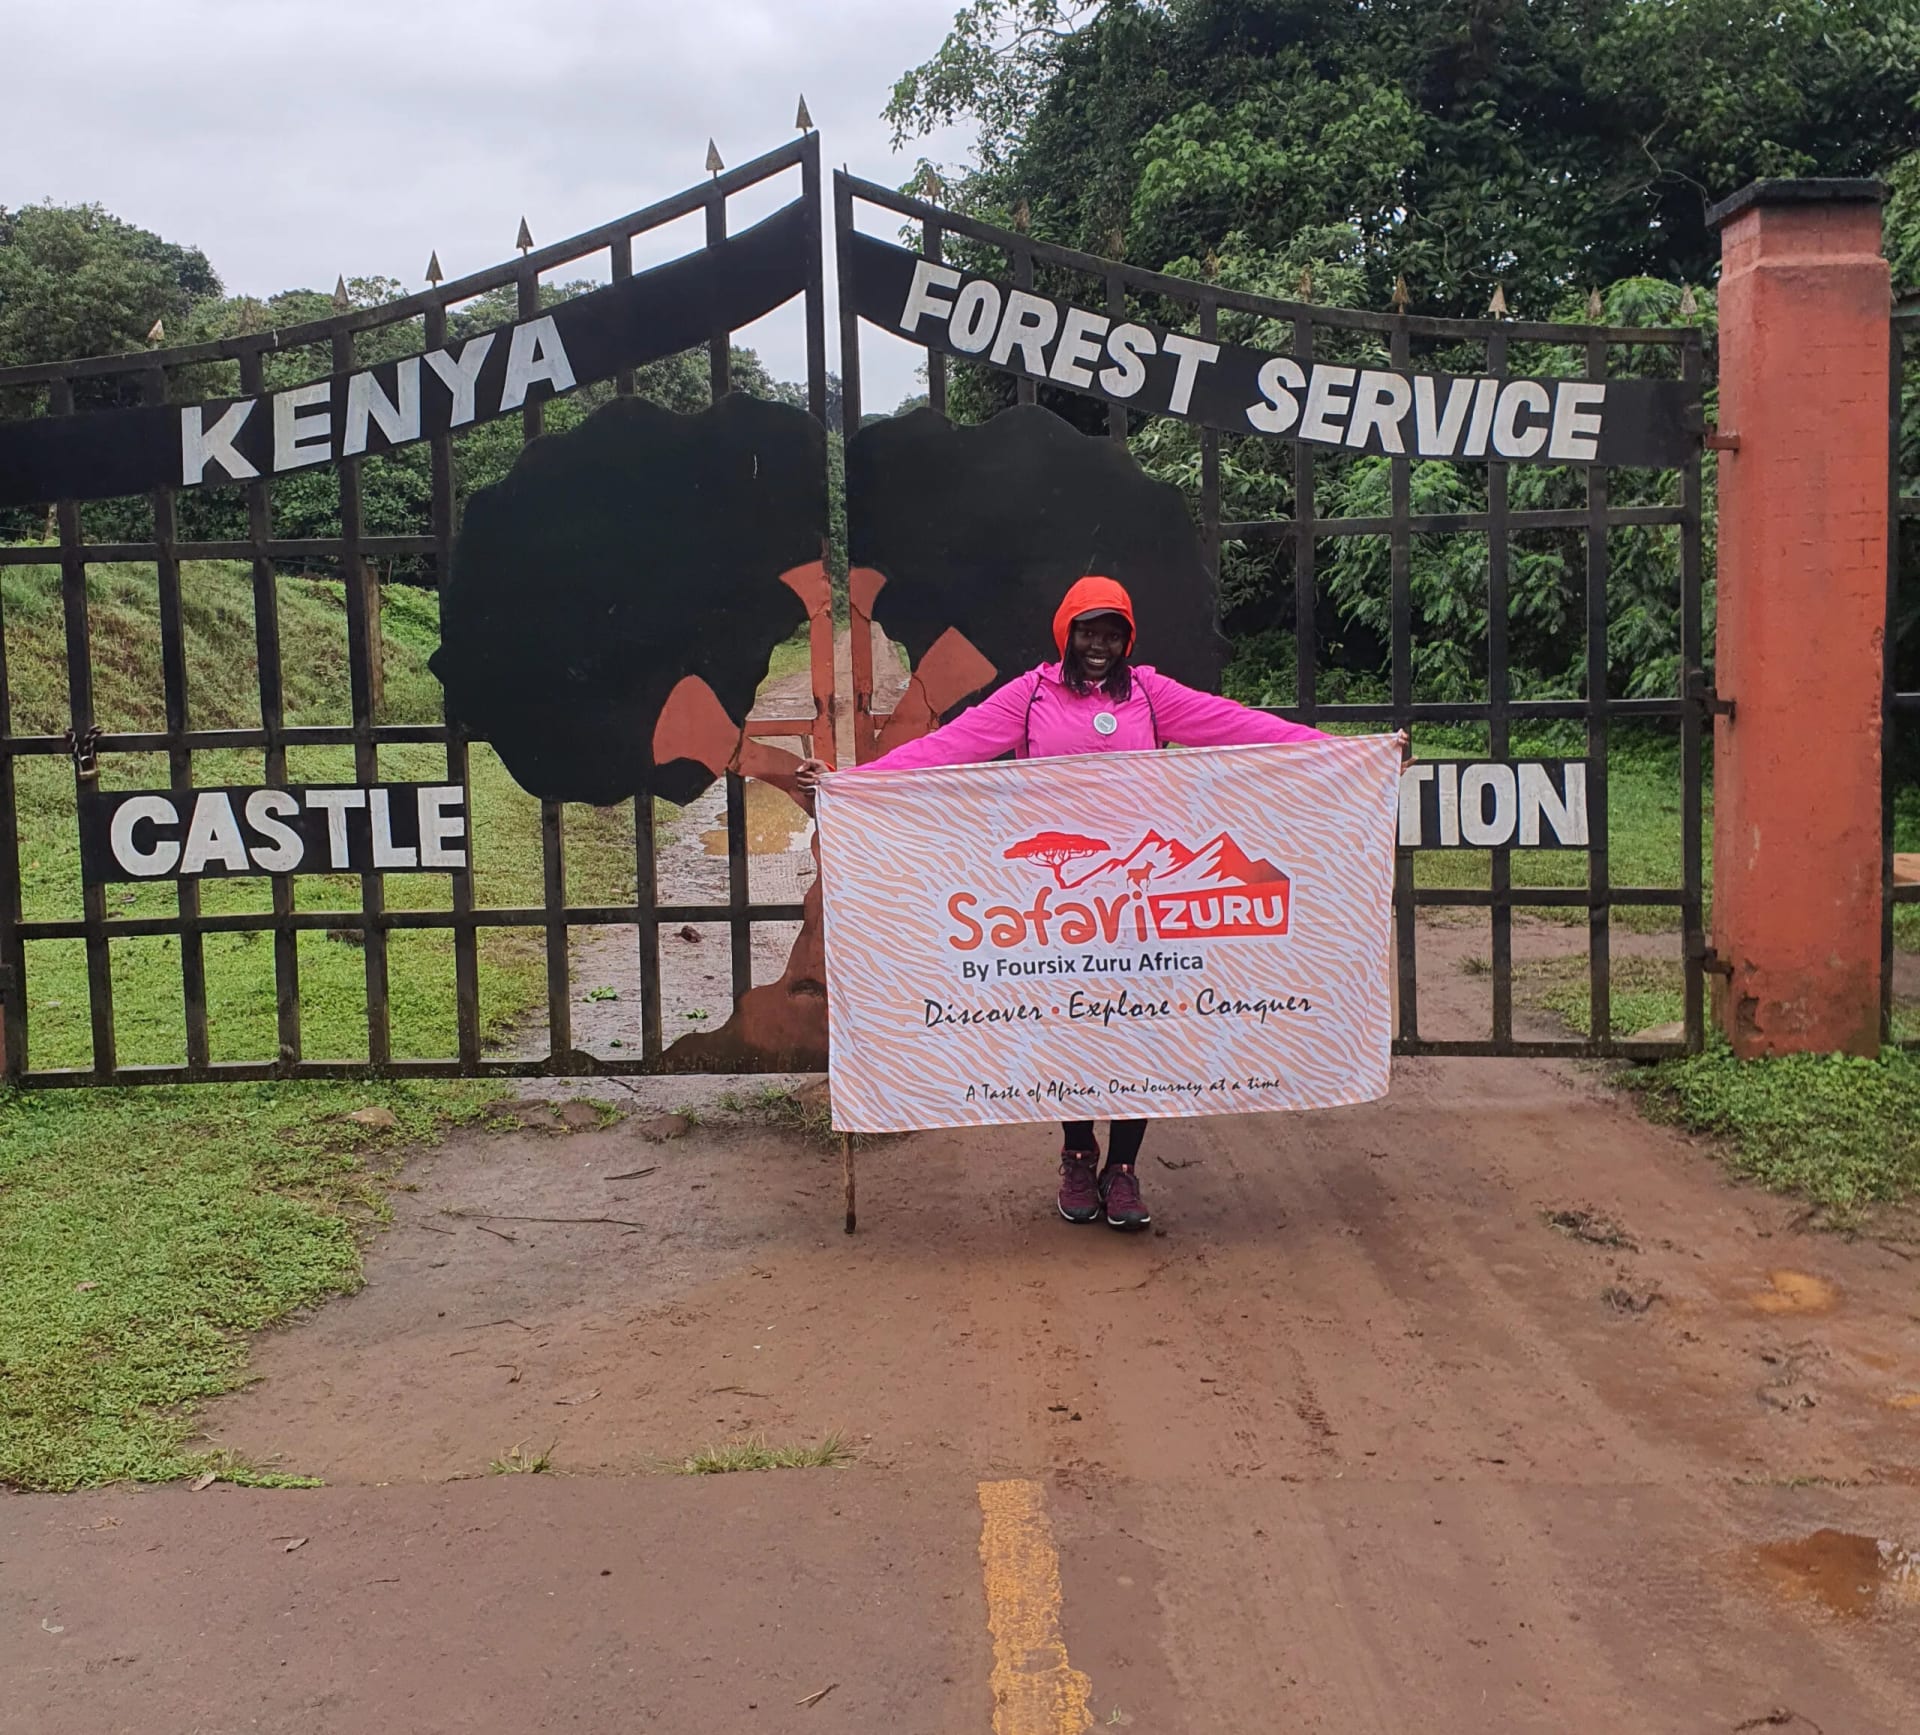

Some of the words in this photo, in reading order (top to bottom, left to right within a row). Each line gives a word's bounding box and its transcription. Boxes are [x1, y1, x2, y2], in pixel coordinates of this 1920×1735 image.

[181, 315, 577, 486] KENYA
[899, 259, 1220, 415] FOREST
[1246, 357, 1606, 461] SERVICE
[111, 786, 467, 877] CASTLE
[963, 961, 989, 983] By
[996, 955, 1075, 977] Foursix
[1082, 954, 1131, 973] Zuru
[1138, 952, 1203, 971] Africa
[923, 998, 1043, 1028] Discover
[1068, 990, 1171, 1027] Explore
[1196, 988, 1312, 1024] Conquer
[965, 1084, 976, 1101] A
[981, 1083, 1021, 1100] Taste
[1026, 1081, 1041, 1102] of
[1046, 1080, 1101, 1102] Africa,
[1108, 1078, 1137, 1094] One
[1142, 1077, 1203, 1097] Journey
[1209, 1077, 1226, 1091] at
[1247, 1077, 1281, 1090] time
